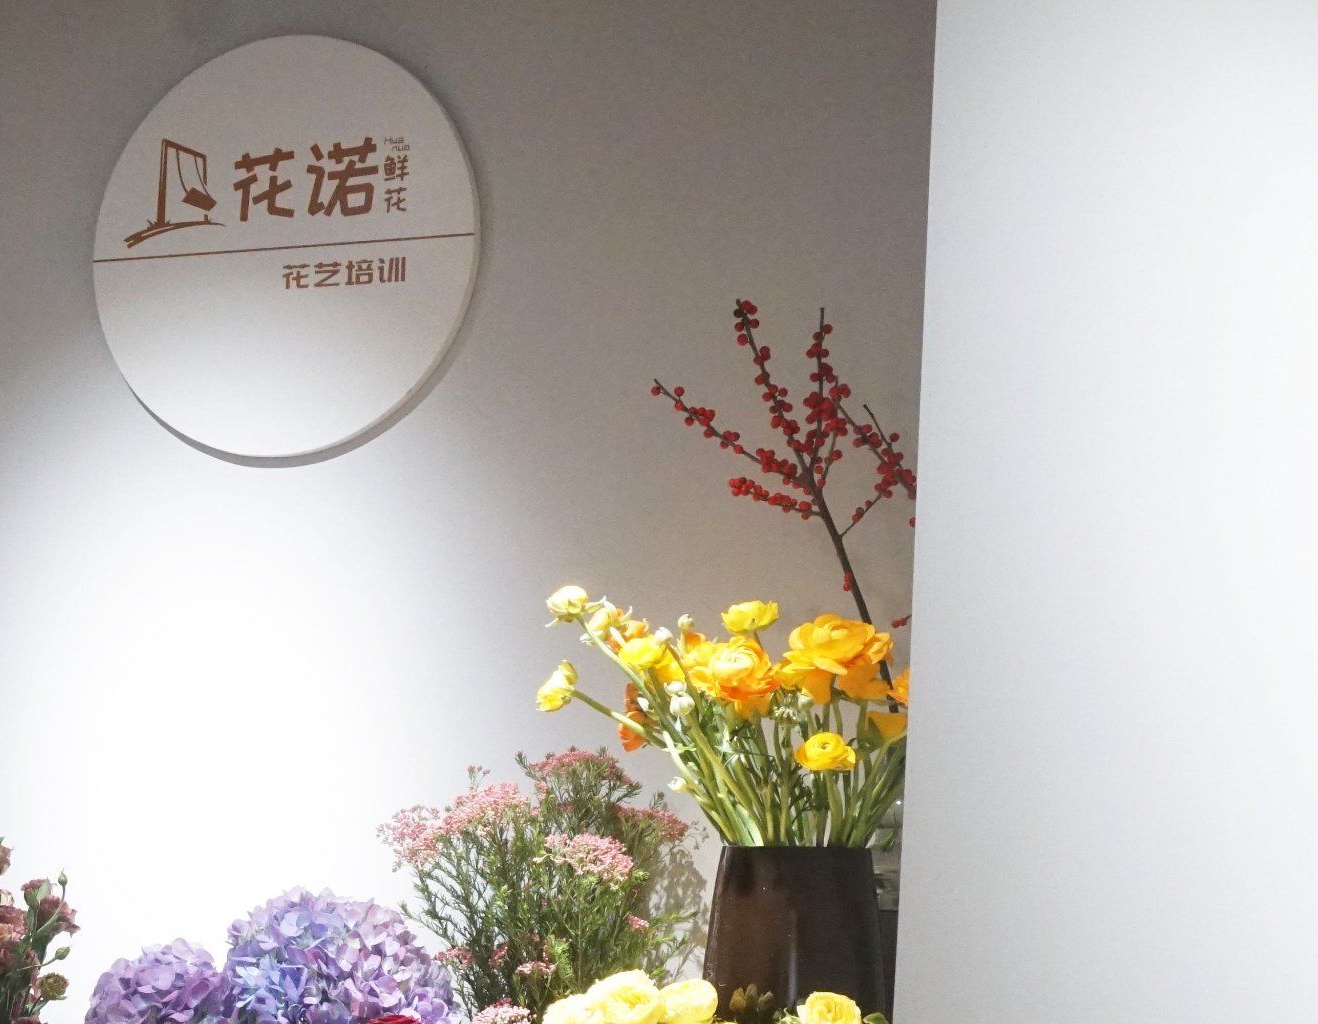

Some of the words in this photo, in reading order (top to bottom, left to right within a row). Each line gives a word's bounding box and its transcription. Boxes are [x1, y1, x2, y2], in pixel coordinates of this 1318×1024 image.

[232, 136, 379, 222] 花诺
[383, 154, 410, 214] 鲜花
[281, 256, 407, 290] 花艺培训
